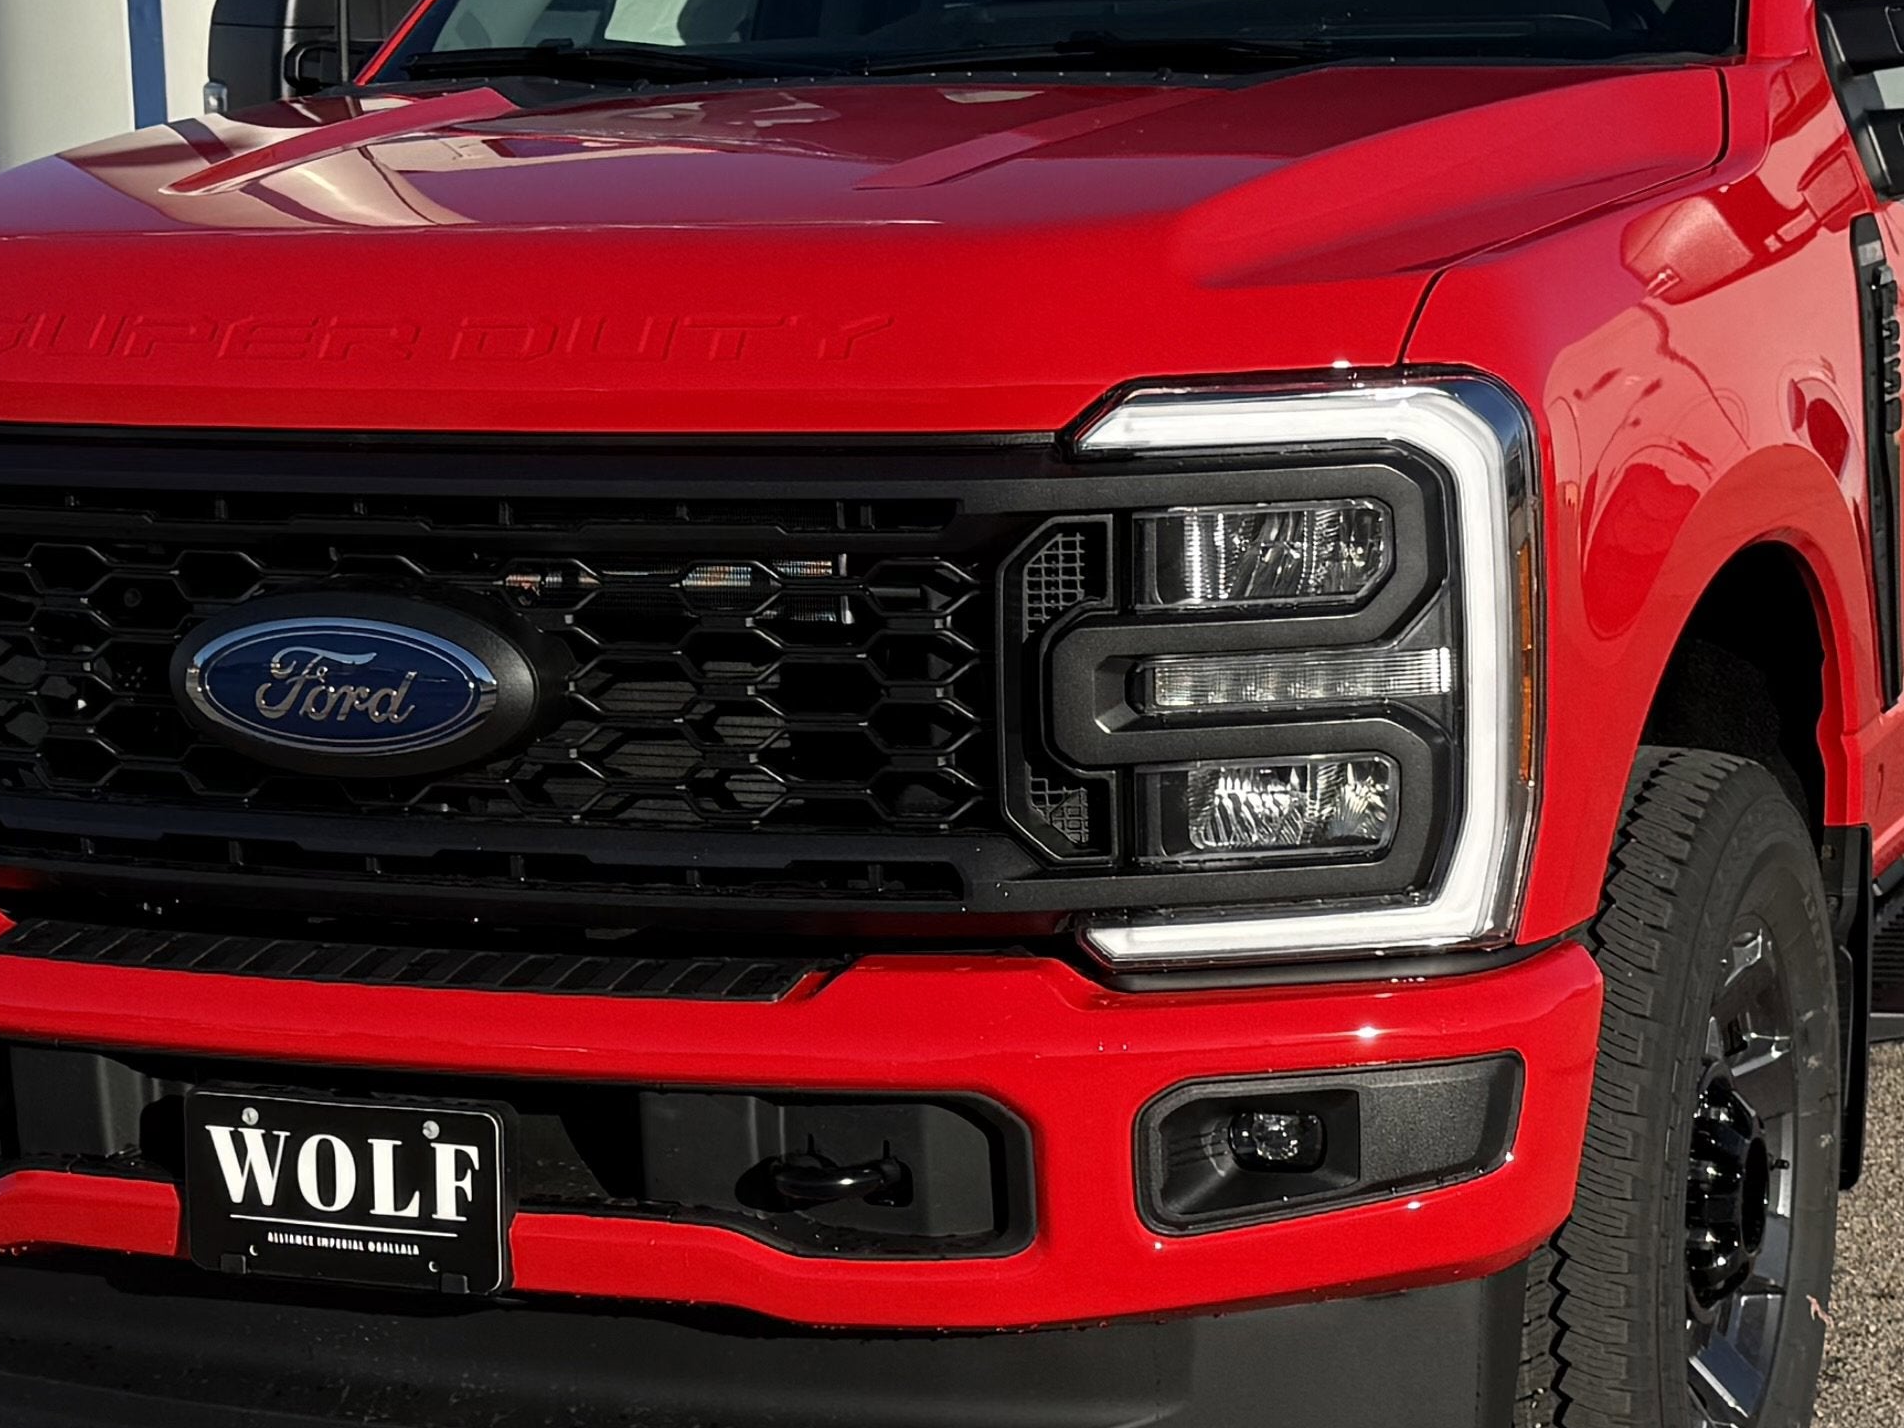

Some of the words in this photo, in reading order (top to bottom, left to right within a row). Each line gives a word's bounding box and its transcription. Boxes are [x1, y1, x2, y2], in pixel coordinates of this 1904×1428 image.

[449, 314, 895, 363] DUTY
[254, 645, 416, 724] Ford
[204, 1124, 480, 1222] WOLF
